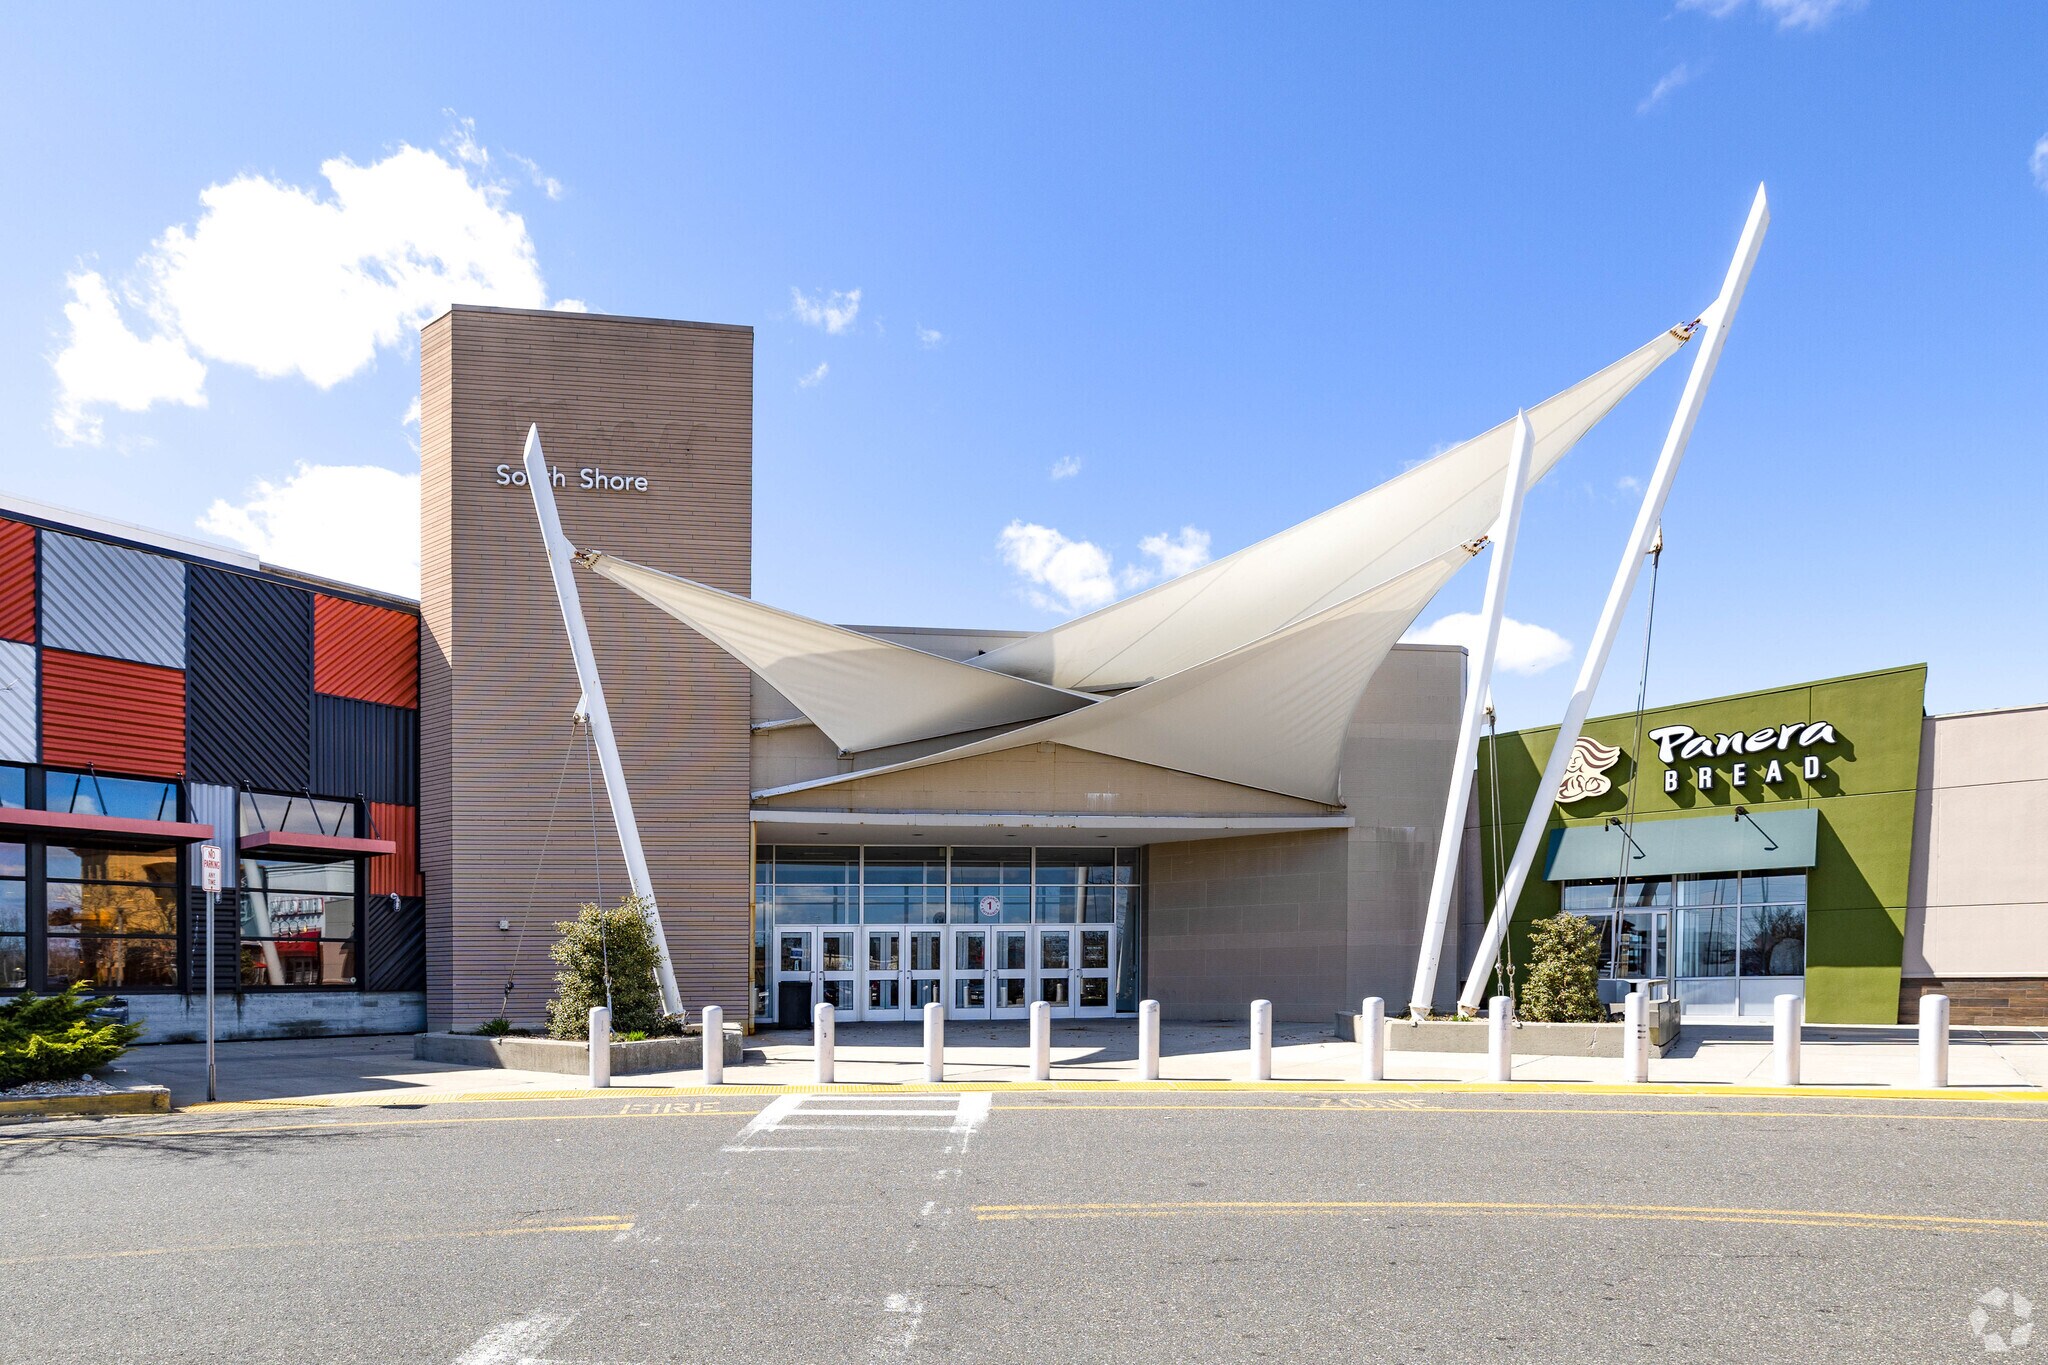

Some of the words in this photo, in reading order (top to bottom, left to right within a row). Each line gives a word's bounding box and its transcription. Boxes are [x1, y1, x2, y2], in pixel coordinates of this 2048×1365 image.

[496, 464, 566, 488] Soh
[580, 467, 648, 492] Shore
[1648, 720, 1838, 765] Panera
[1663, 755, 1822, 794] BREAD
[207, 850, 215, 859] NO
[203, 859, 220, 869] PARKING
[987, 901, 992, 910] 1
[619, 1101, 721, 1115] FIRE
